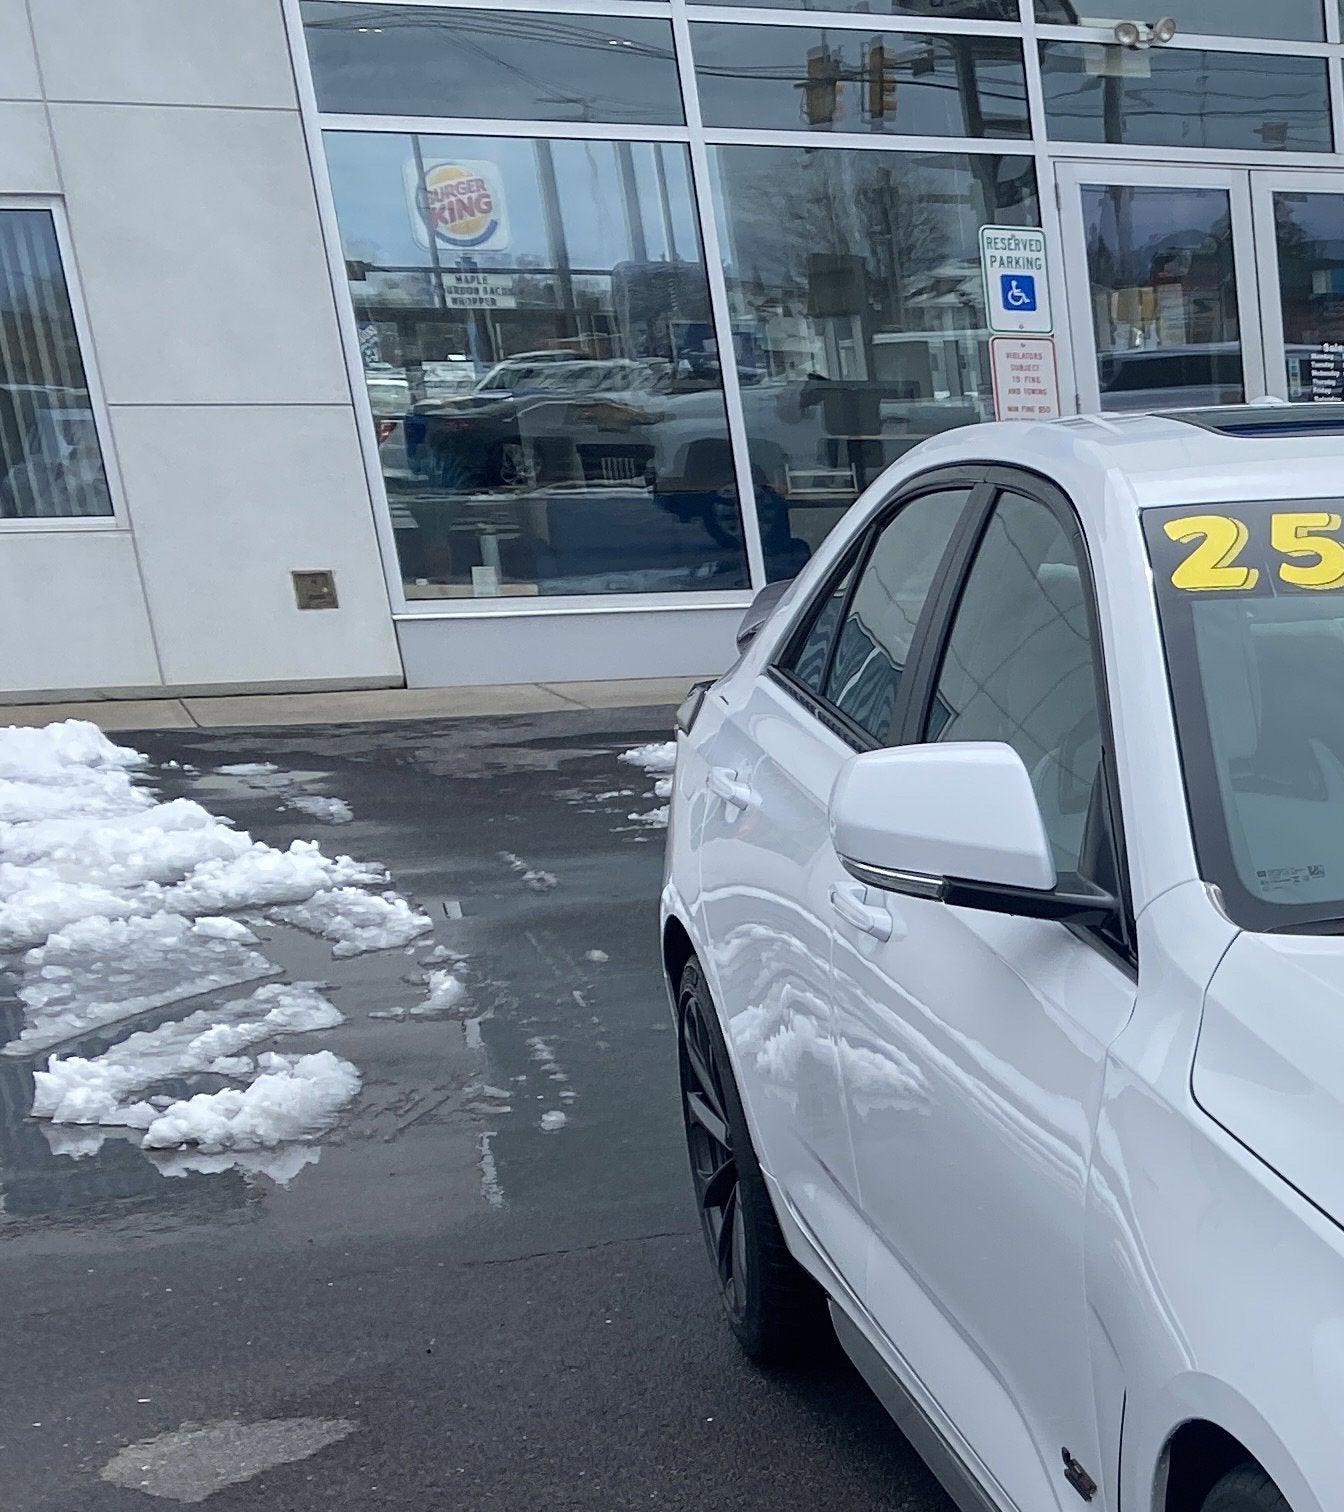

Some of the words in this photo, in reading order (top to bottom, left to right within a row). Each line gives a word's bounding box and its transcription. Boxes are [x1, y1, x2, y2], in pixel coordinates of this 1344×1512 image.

[430, 192, 493, 229] KING
[986, 236, 1042, 252] RESERVED
[990, 255, 1042, 270] PARKING
[1024, 376, 1041, 384] FINE
